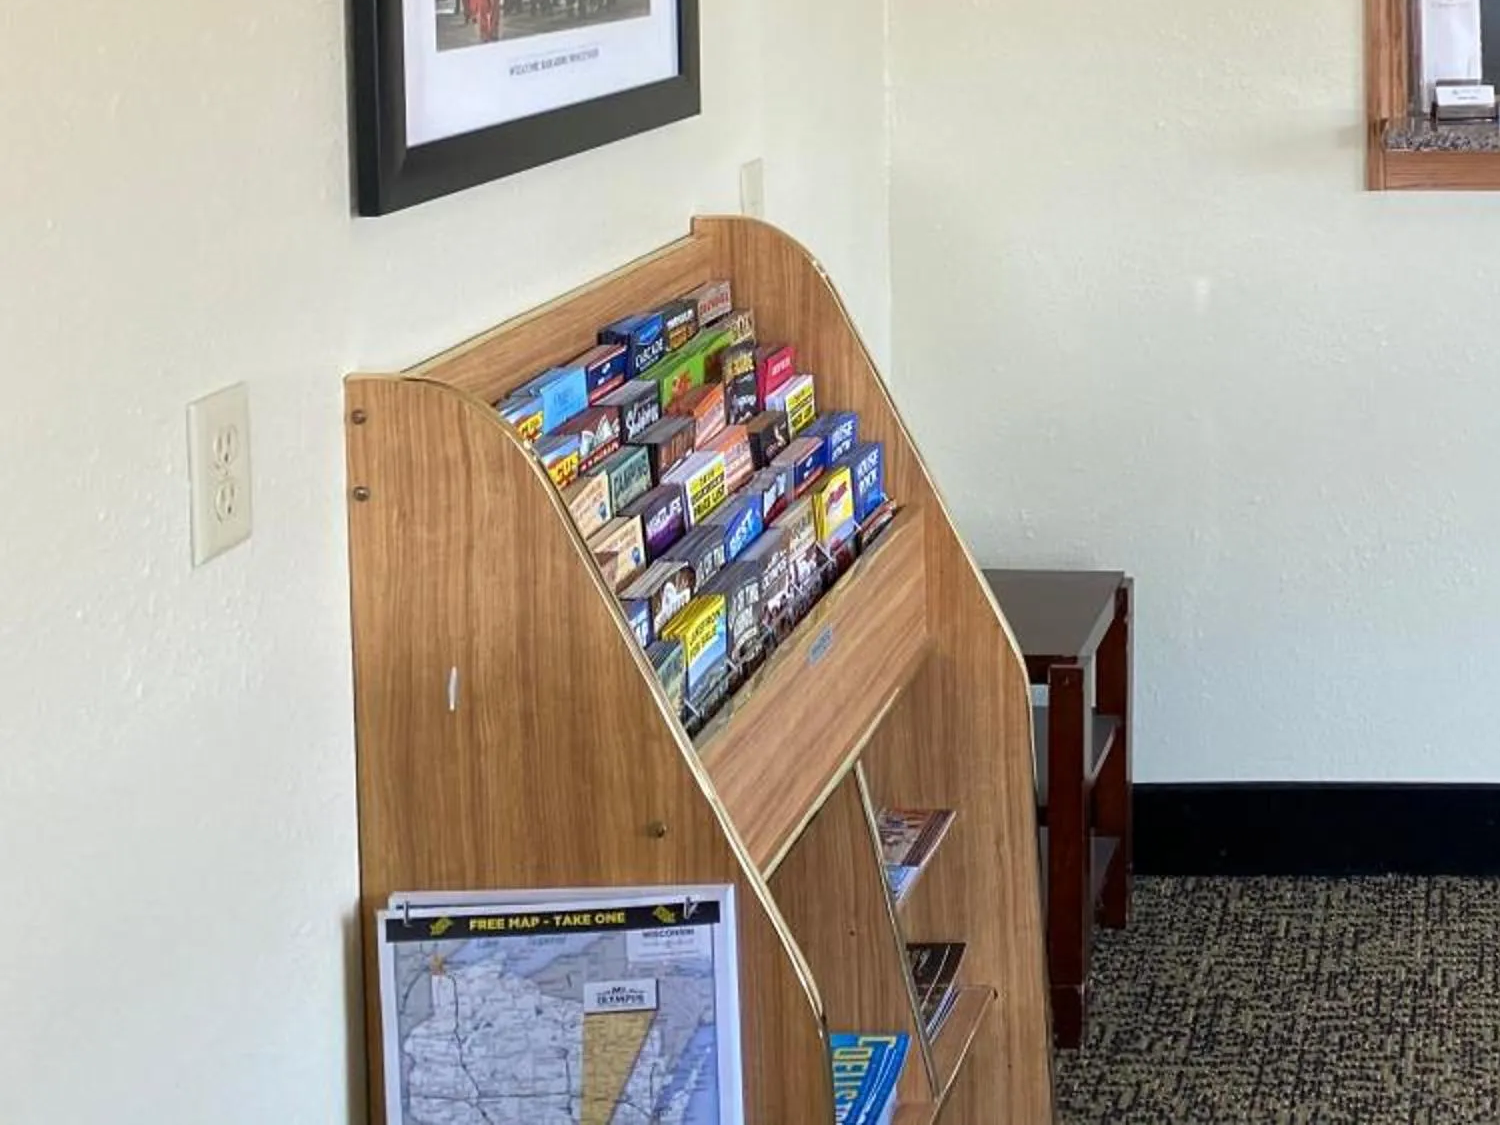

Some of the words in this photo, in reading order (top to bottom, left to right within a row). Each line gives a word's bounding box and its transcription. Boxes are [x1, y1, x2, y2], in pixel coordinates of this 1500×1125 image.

[469, 918, 506, 931] FREE
[508, 916, 540, 929] MAP
[554, 913, 591, 927] TAKE
[594, 911, 626, 925] ONE
